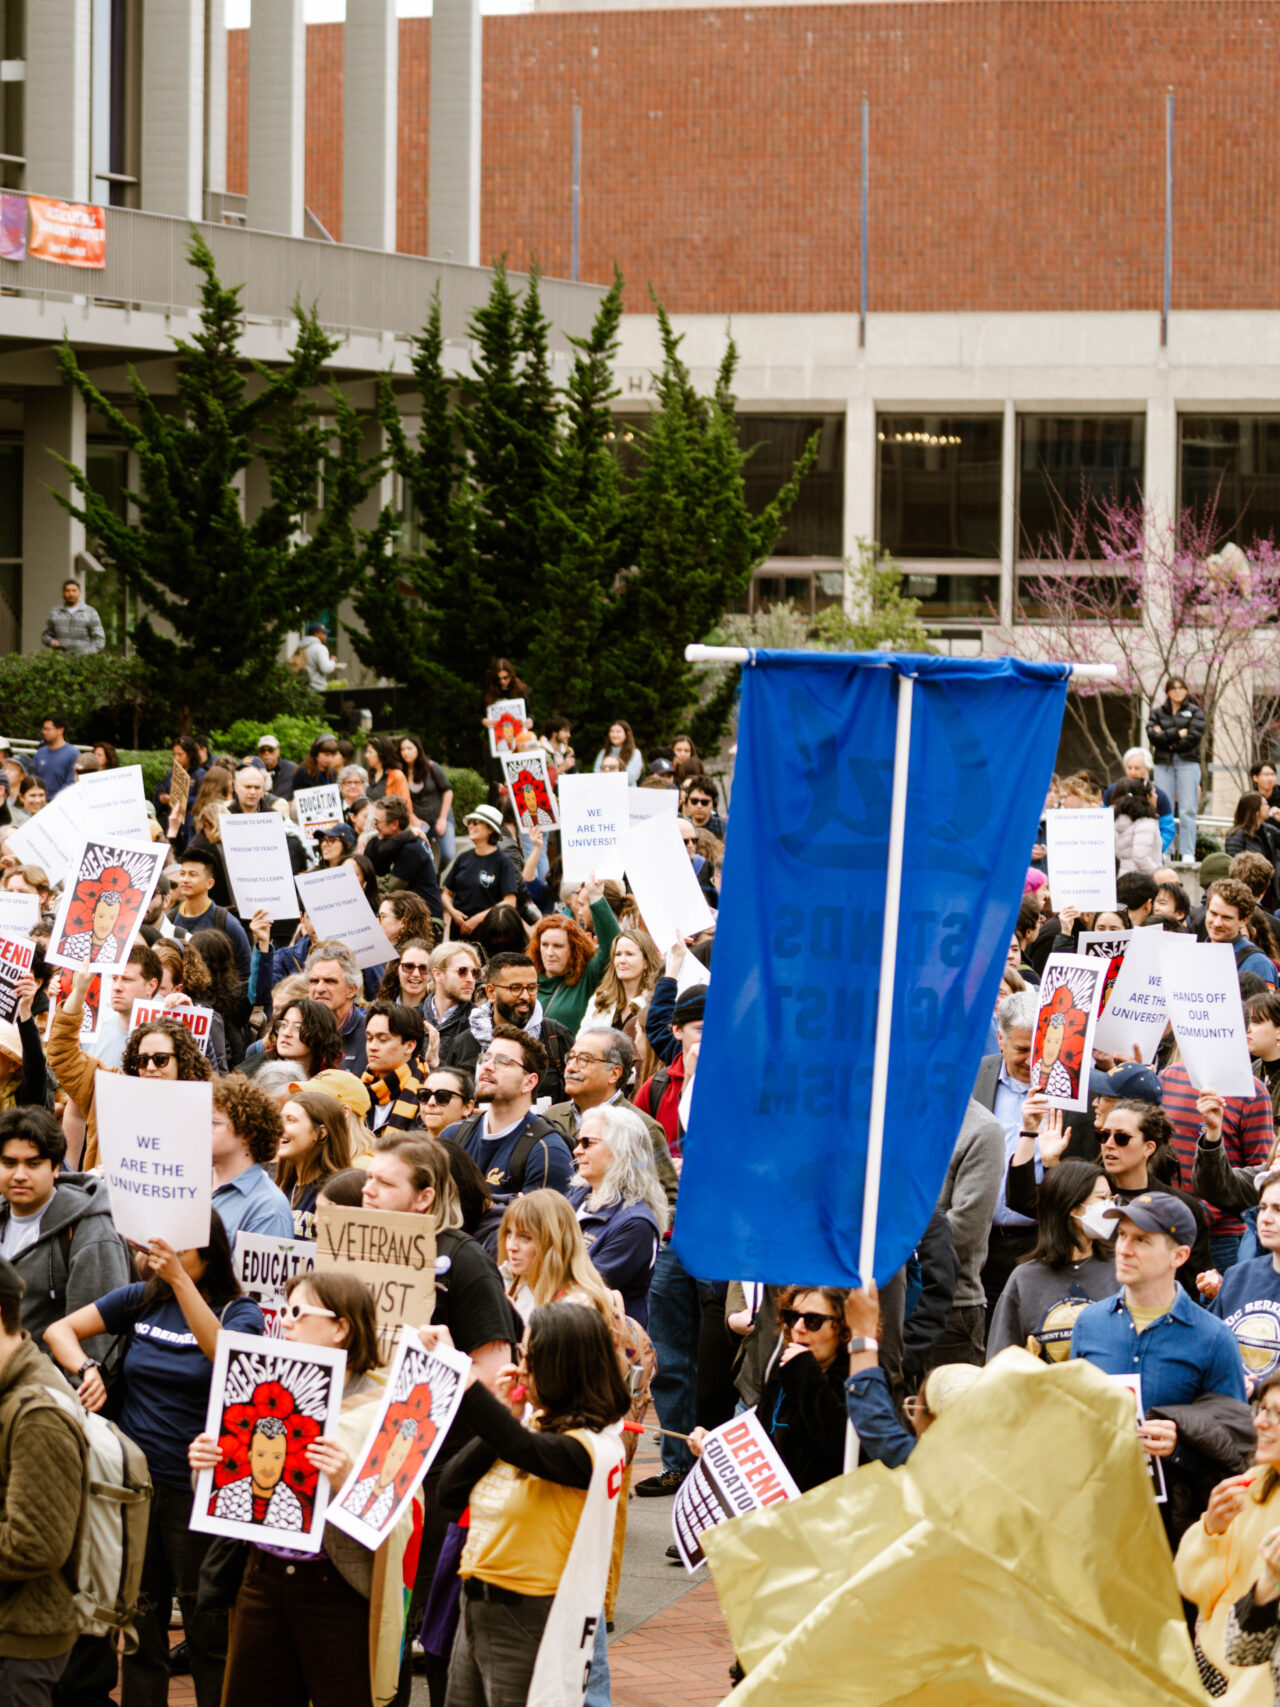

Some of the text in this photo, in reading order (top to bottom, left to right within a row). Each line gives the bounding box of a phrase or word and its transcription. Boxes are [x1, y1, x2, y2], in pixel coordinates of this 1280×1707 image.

[299, 791, 337, 814] EDUCATION
[587, 809, 602, 817] WE
[577, 823, 616, 833] ARE THE
[304, 877, 325, 886] FREEDOM
[332, 872, 347, 880] SPEAK
[313, 905, 334, 913] FREEDOM
[342, 898, 358, 907] TEACH
[325, 933, 348, 941] FREEDOM
[355, 926, 372, 935] LEARN
[1148, 976, 1162, 986] WE
[1129, 993, 1166, 1007] ARE THE
[1173, 992, 1227, 1003] HANDS OFF
[1112, 1007, 1167, 1024] UNIVERSITY
[1189, 1010, 1209, 1020] OUR
[1177, 1025, 1235, 1039] COMMUNITY
[137, 1136, 160, 1150] WE
[120, 1157, 184, 1178] ARE THE
[486, 1167, 505, 1186] Cal
[110, 1175, 198, 1200] UNIVERSITY
[326, 1222, 425, 1271] VETERANS
[1224, 1308, 1243, 1326] UC
